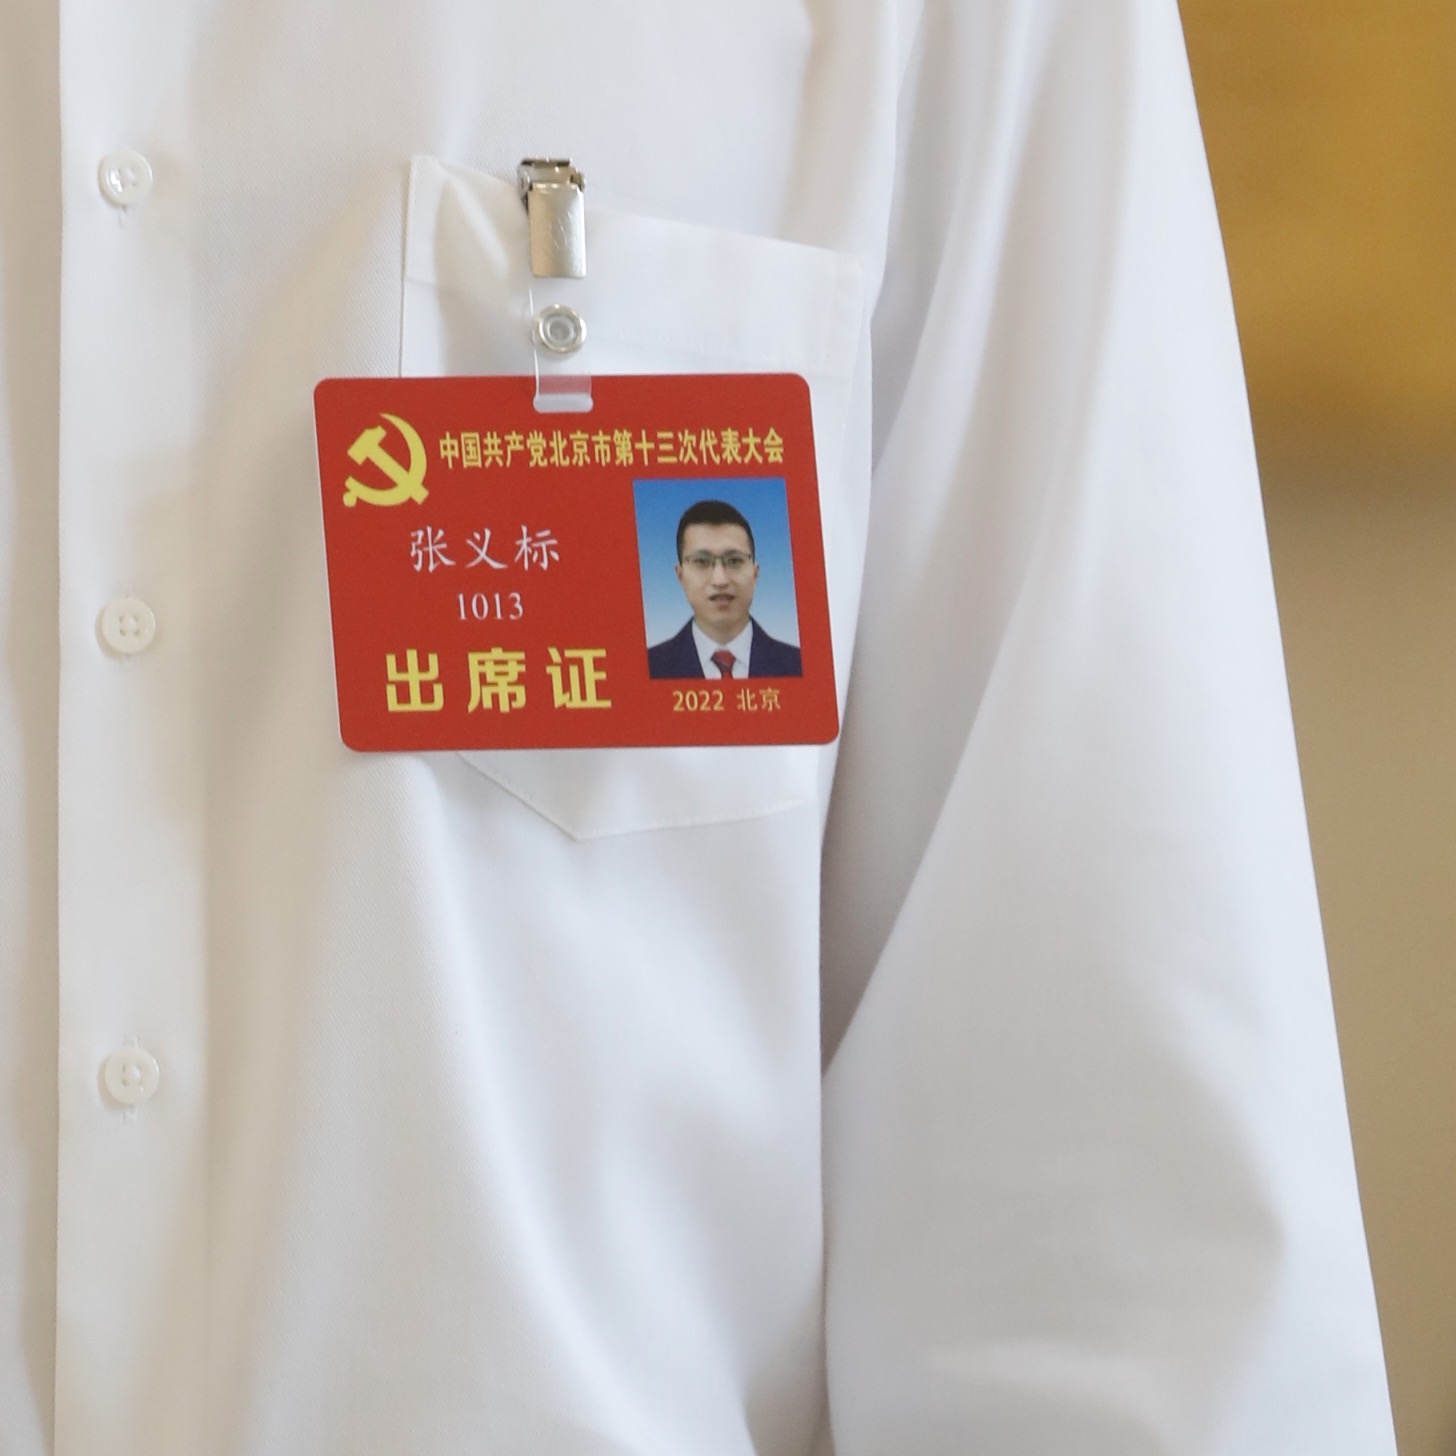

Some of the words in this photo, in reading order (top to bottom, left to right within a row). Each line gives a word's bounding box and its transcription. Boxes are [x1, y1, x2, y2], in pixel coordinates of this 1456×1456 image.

[439, 427, 785, 469] 中国共产党北京市第十三次代表大会
[409, 525, 560, 573] 张义标
[457, 592, 524, 621] 1013
[385, 646, 612, 713] 出席证
[672, 690, 725, 712] 2022
[737, 686, 782, 712] 北京
